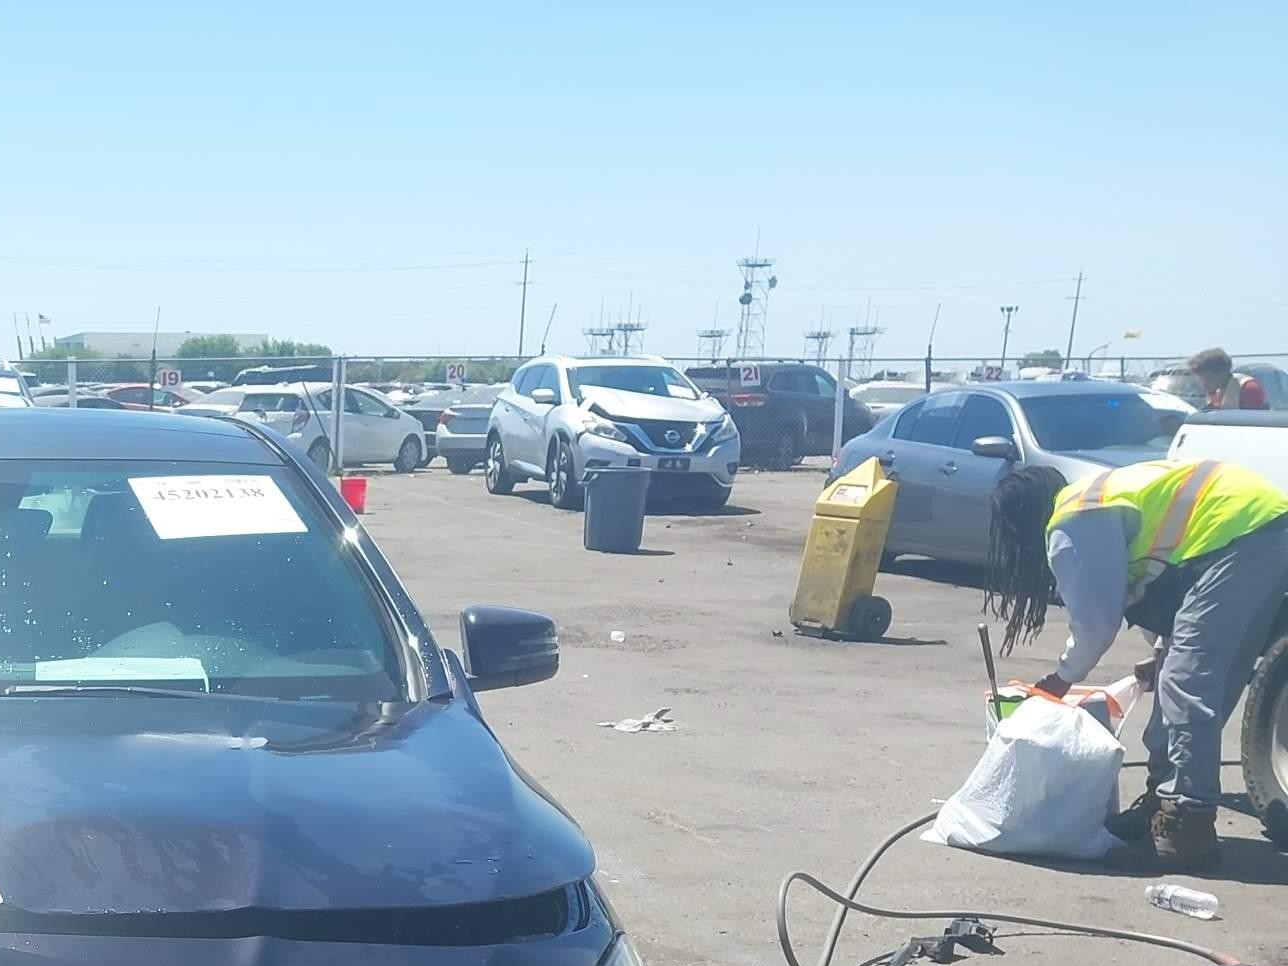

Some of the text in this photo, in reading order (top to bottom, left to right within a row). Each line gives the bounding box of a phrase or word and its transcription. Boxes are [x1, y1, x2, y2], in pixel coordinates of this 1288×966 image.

[162, 372, 179, 386] 19
[448, 365, 464, 379] 20
[743, 367, 758, 381] 21
[985, 367, 1001, 381] 22
[153, 488, 265, 501] 45202138
